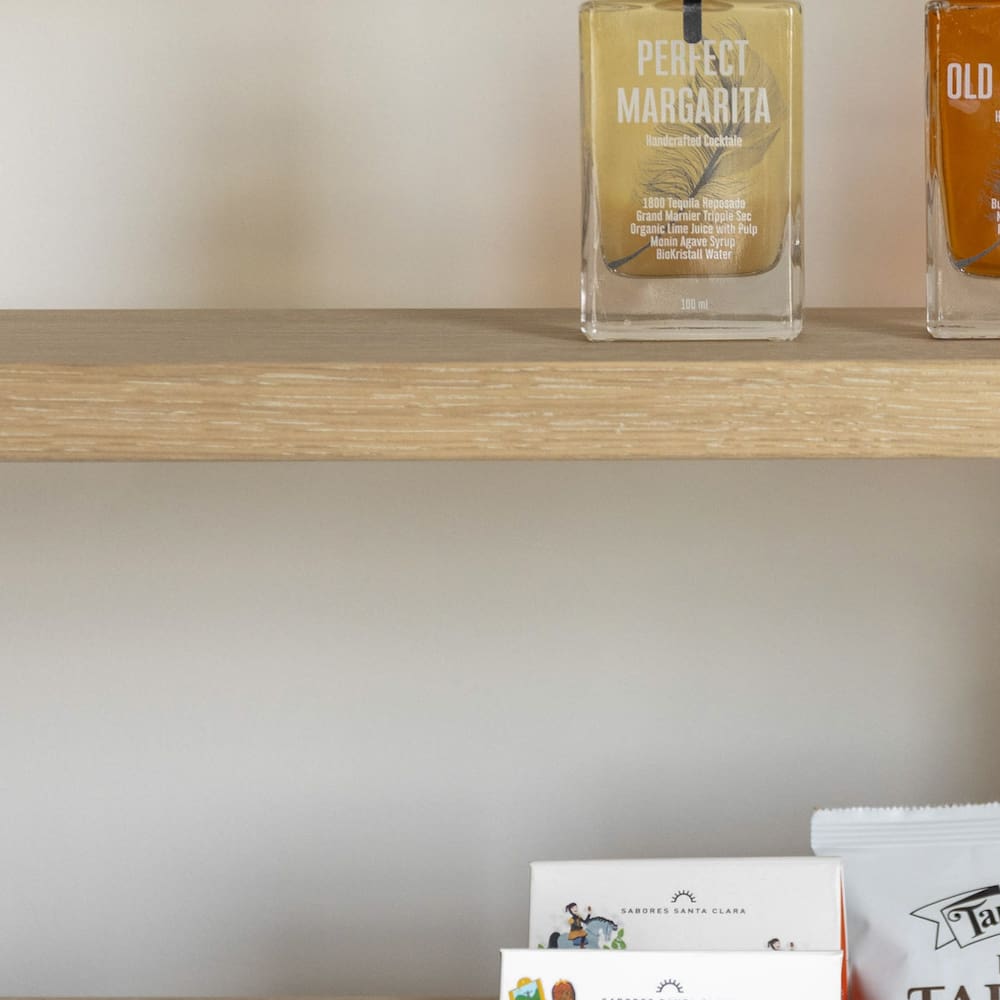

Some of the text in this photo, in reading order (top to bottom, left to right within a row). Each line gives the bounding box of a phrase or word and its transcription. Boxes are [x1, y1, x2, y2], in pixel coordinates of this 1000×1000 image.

[638, 40, 749, 76] PERFECT
[947, 63, 993, 100] OLD
[617, 87, 771, 124] MARGARITA
[646, 135, 702, 147] Handcrafted
[642, 197, 746, 211] 1800 Tequila Reposado
[636, 210, 662, 222] Grand
[665, 210, 701, 222] Marnier
[736, 210, 752, 222] Sec
[630, 223, 757, 237] Organic Lime Juice with Pulp
[650, 235, 736, 250] Monin Agave Syrup
[656, 248, 732, 260] BioKristall Water
[681, 298, 709, 310] 100 ml
[621, 907, 670, 915] SABORES
